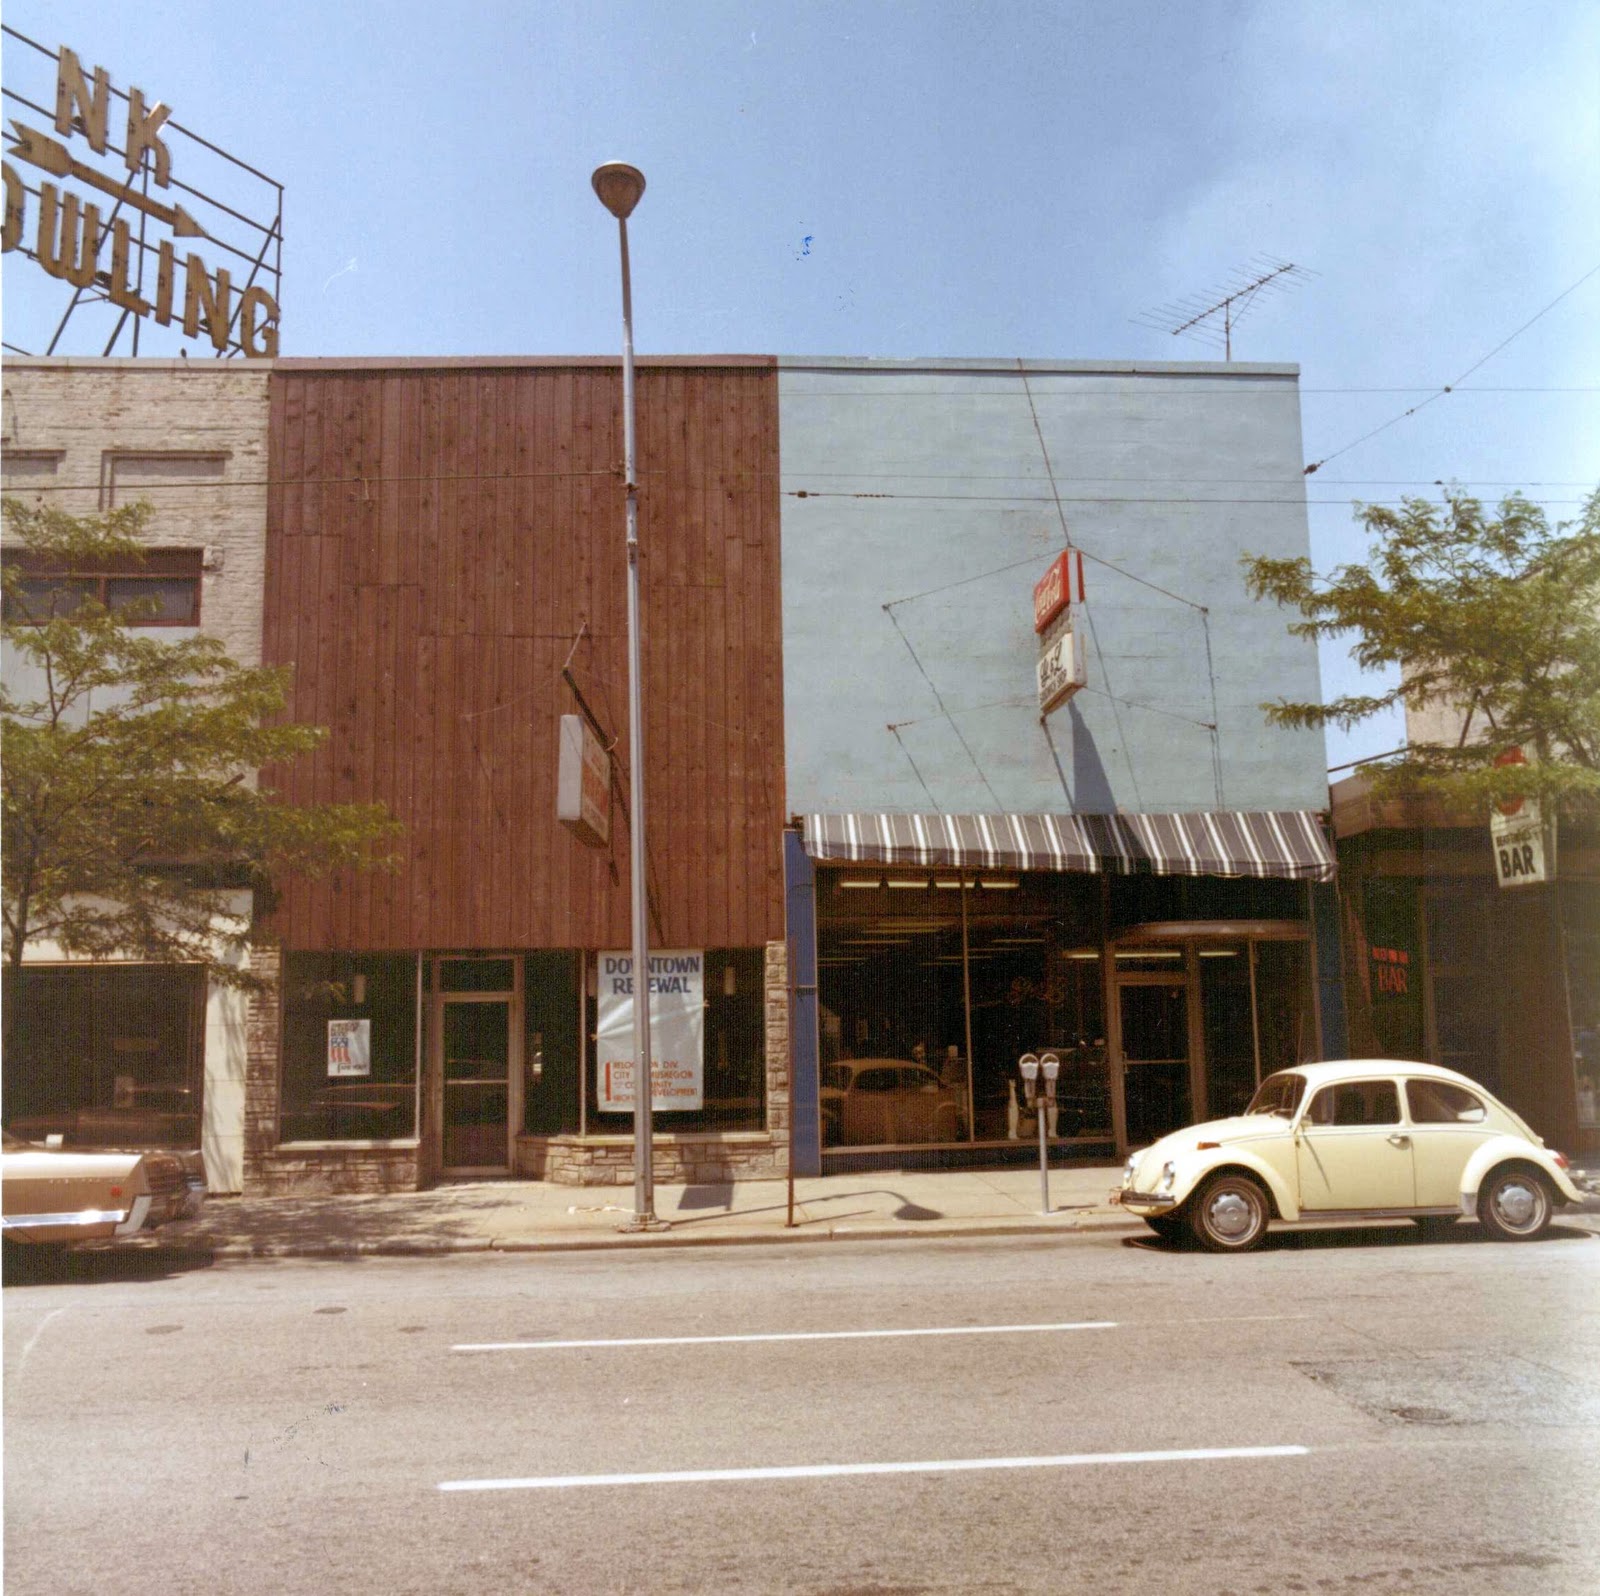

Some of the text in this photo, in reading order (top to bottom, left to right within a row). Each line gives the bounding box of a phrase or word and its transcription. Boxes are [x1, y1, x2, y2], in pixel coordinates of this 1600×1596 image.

[1499, 845, 1536, 879] BAR
[605, 956, 700, 975] DONTOWN
[612, 977, 692, 995] REEWAL
[613, 1071, 630, 1080] CITY
